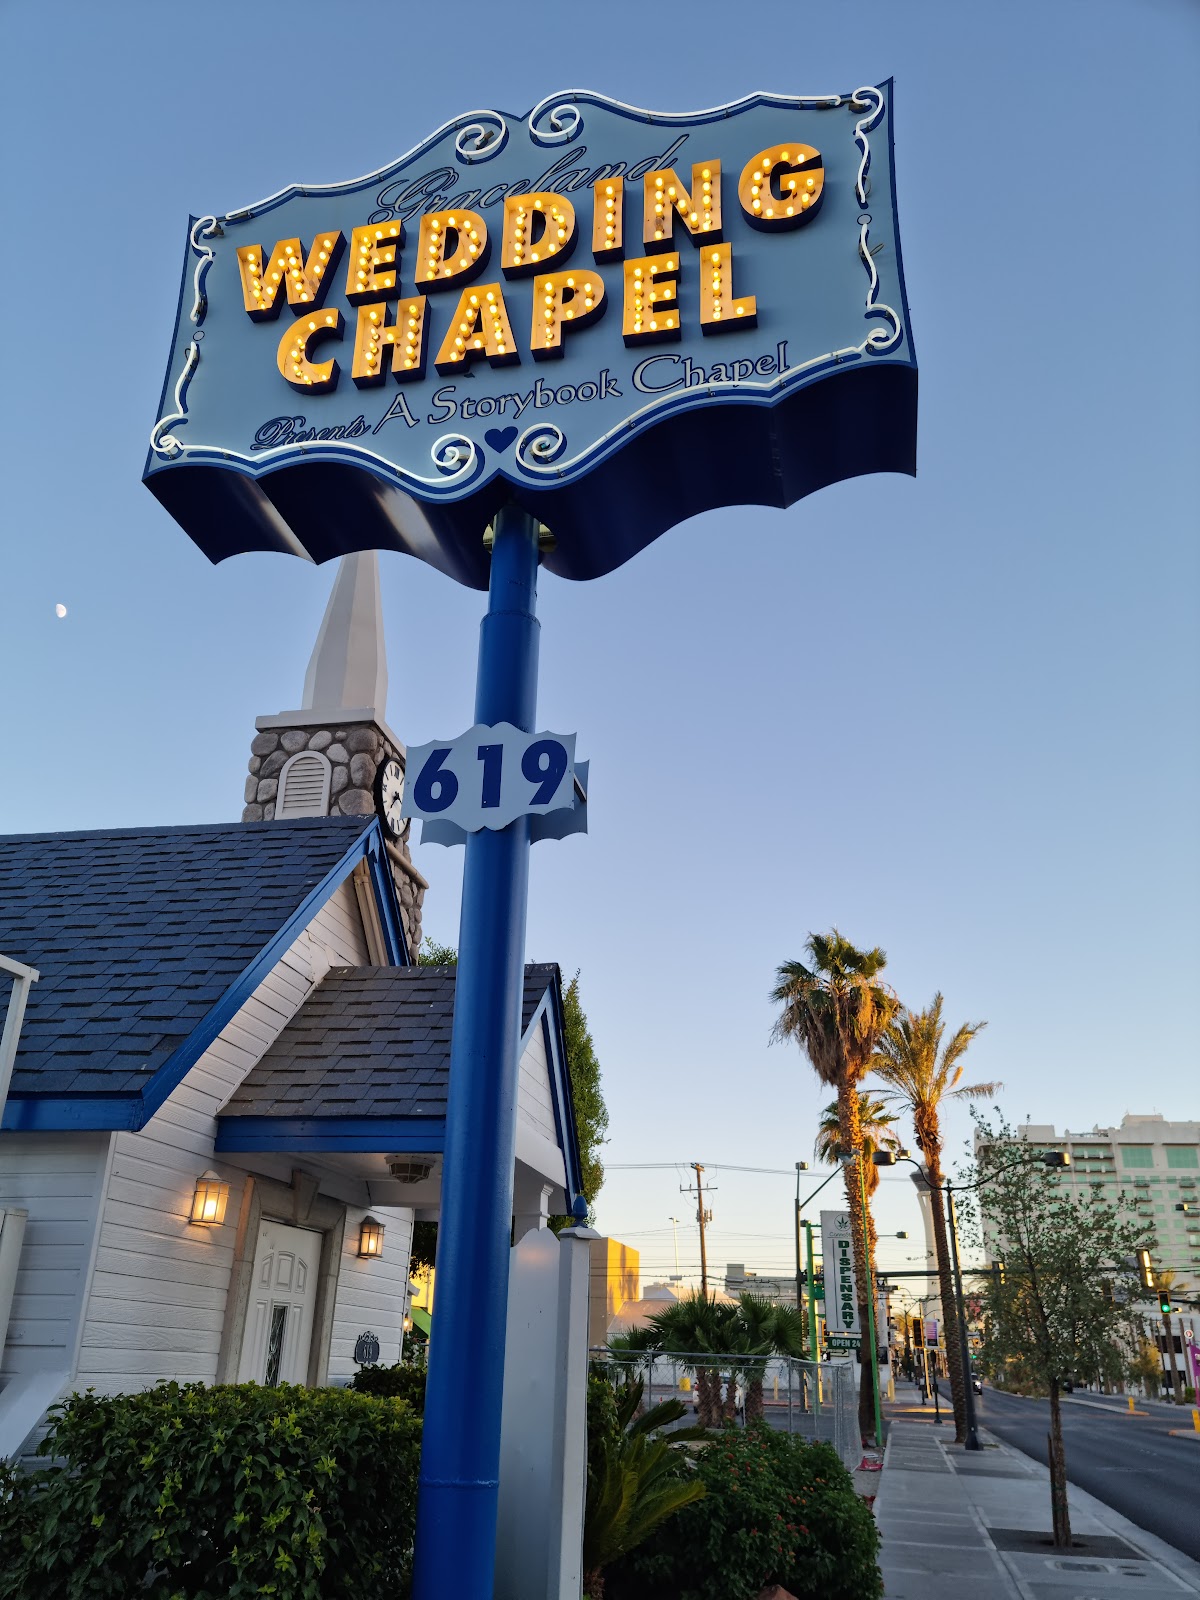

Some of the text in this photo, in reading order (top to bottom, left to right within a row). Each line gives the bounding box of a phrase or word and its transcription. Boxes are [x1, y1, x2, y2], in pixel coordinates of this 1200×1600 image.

[367, 133, 690, 225] Graceland
[236, 142, 825, 320] WEDDING
[277, 242, 758, 393] CHAPEL
[250, 340, 790, 450] Presents A Storybook Chapel
[413, 739, 568, 813] 619
[837, 1240, 855, 1329] DISPENSARY
[831, 1338, 861, 1348] OPEN 24
